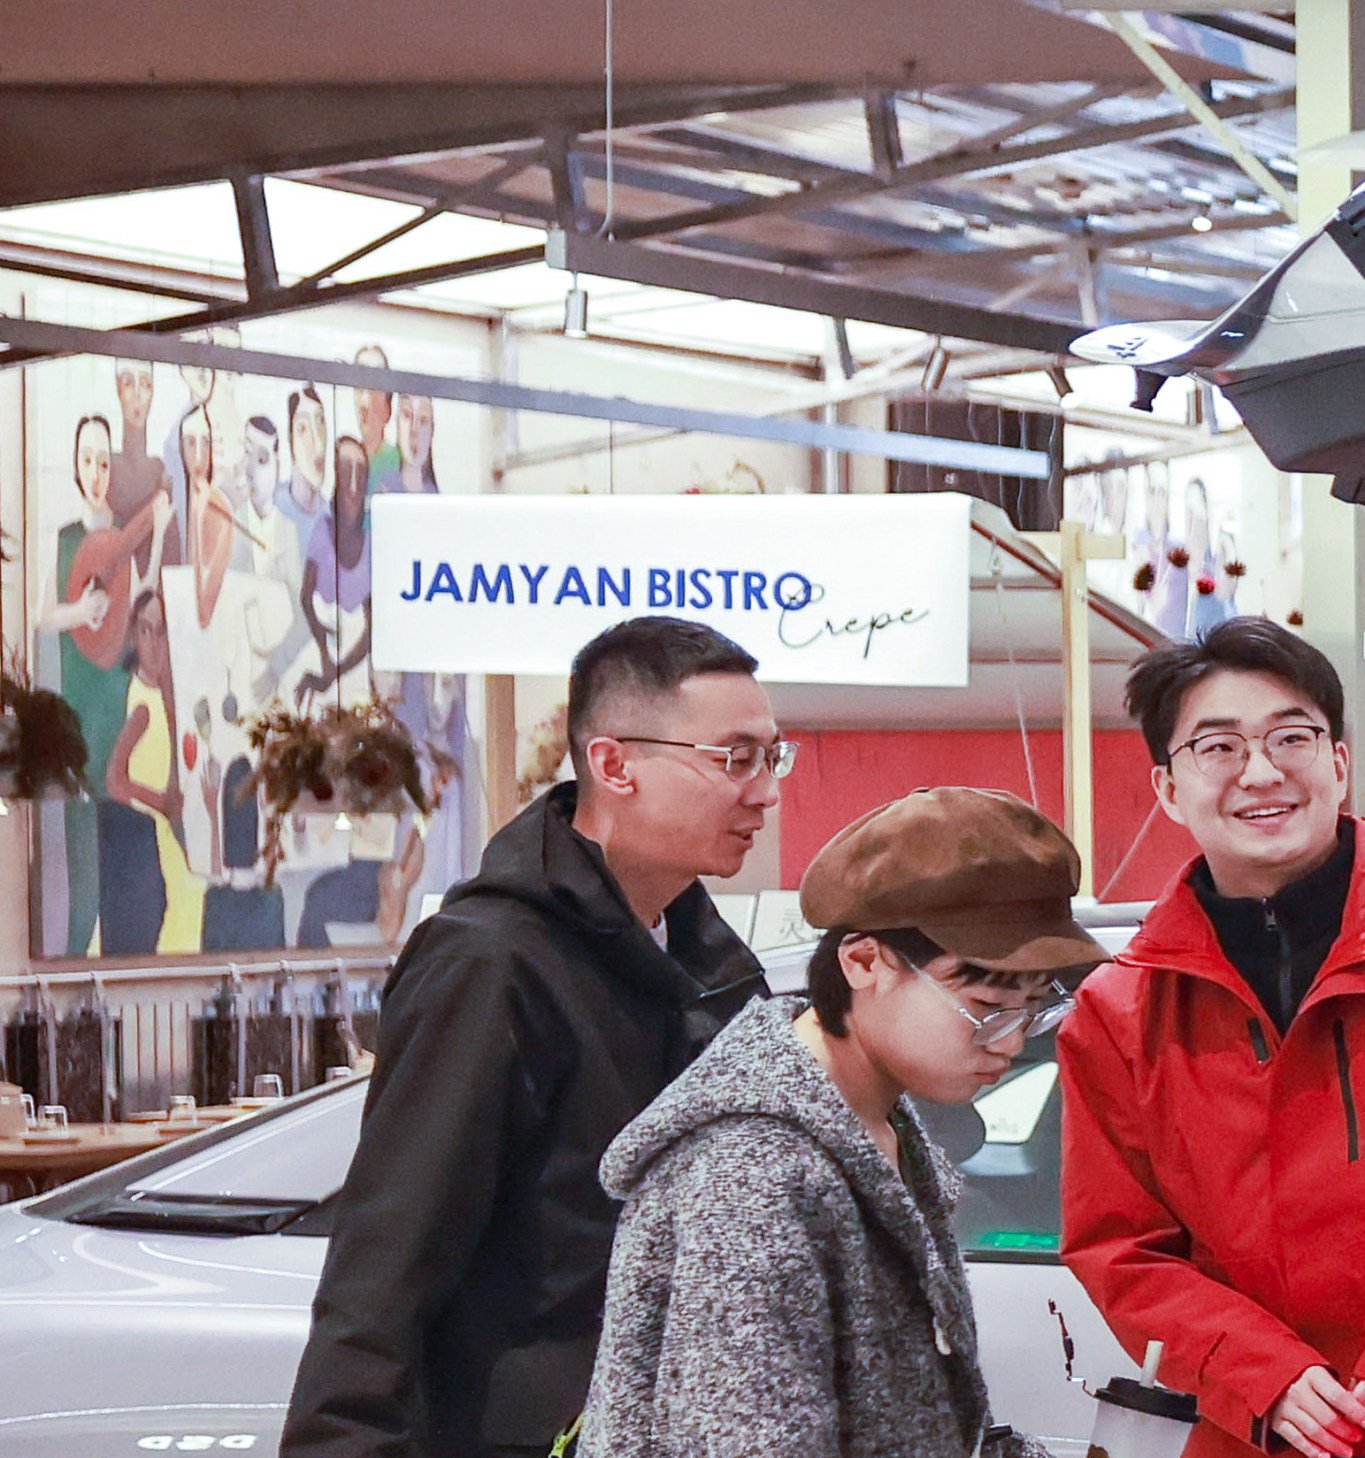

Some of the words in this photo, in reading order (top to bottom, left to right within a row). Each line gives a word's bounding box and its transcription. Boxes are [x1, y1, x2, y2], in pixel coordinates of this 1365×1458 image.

[400, 559, 633, 607] JAMYAN
[646, 566, 814, 612] BISTRO
[777, 582, 931, 660] Crepe
